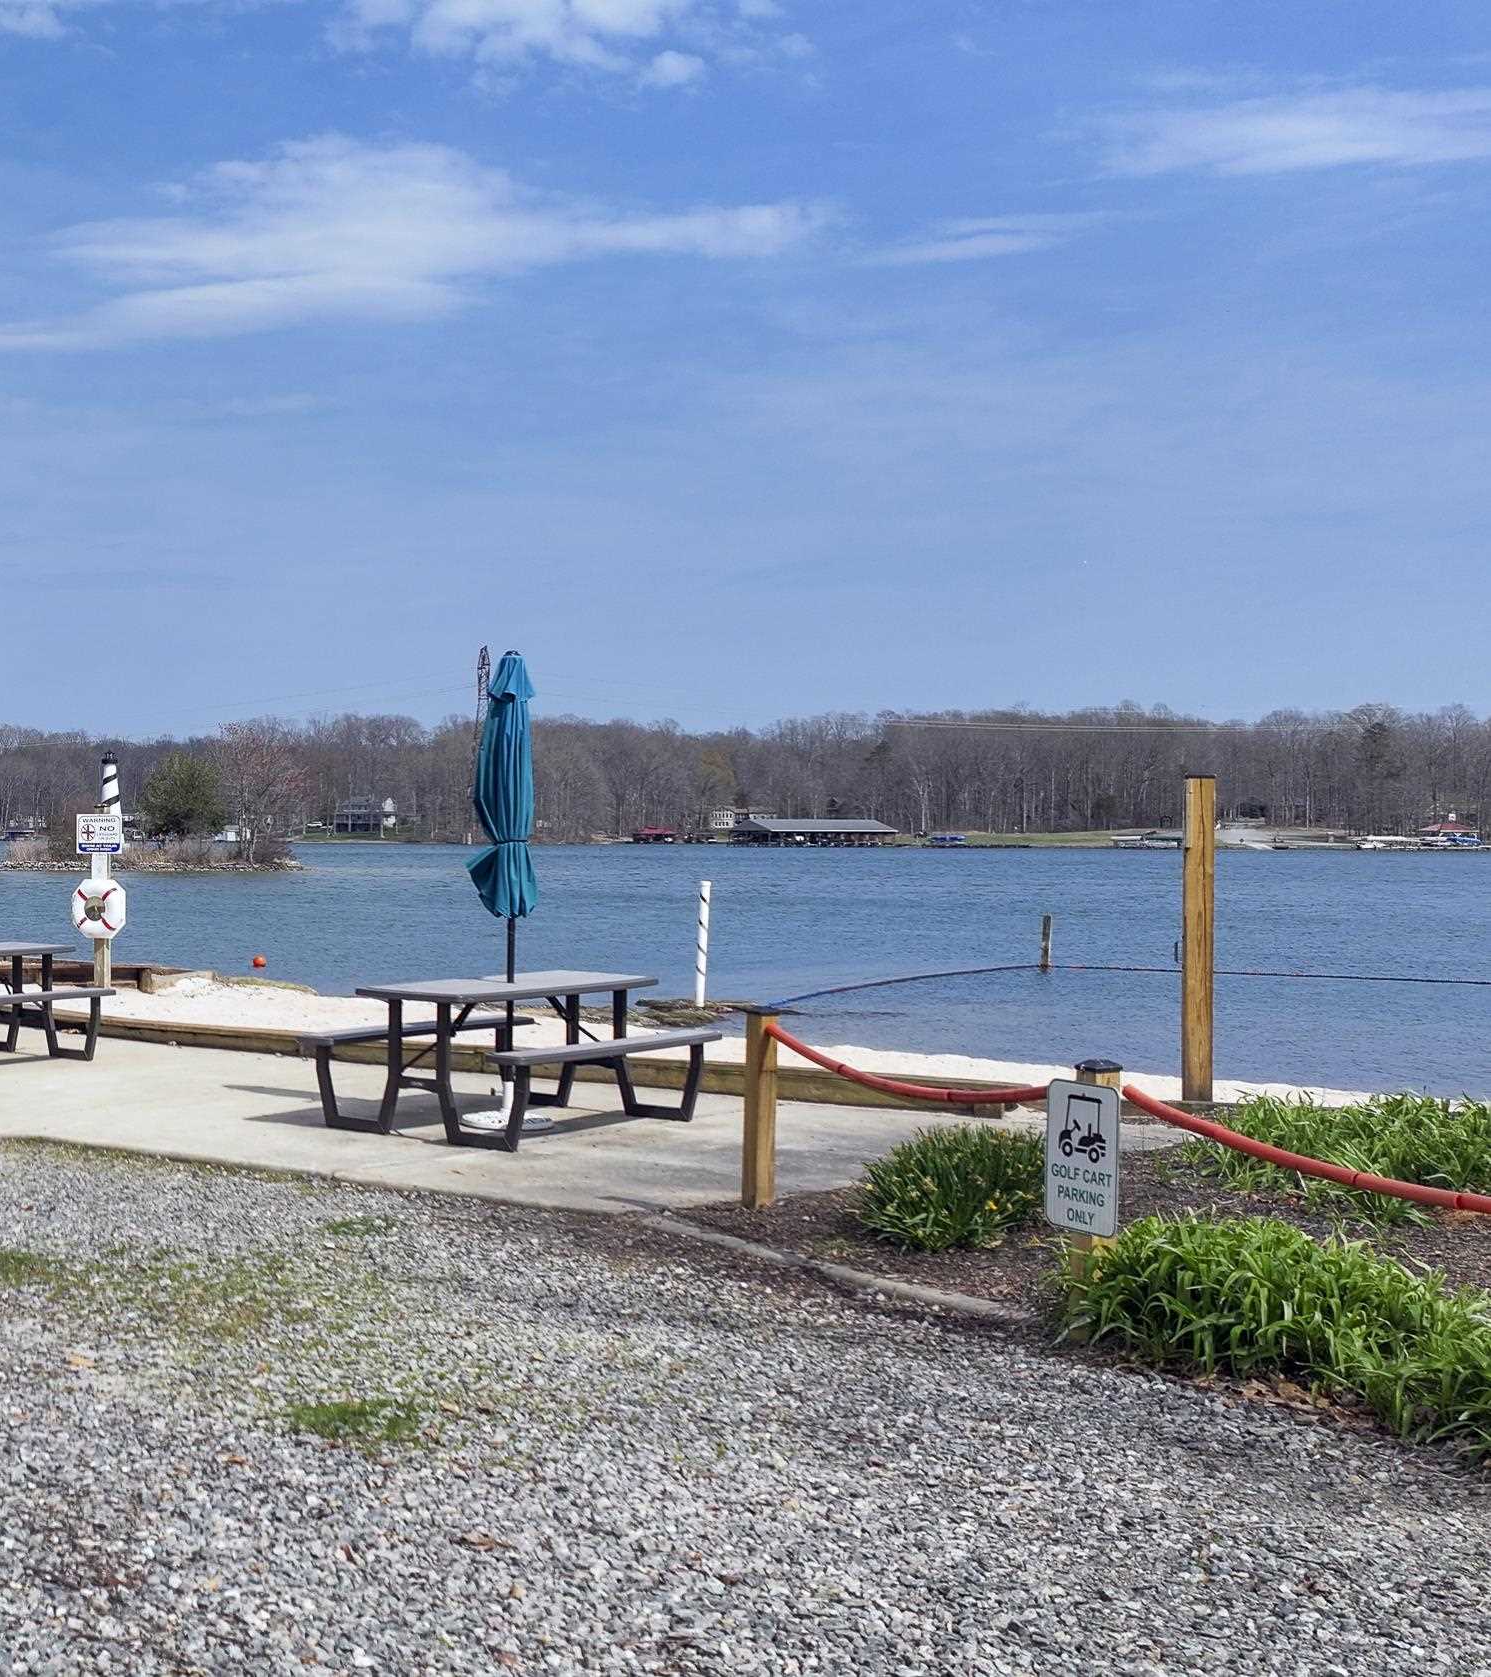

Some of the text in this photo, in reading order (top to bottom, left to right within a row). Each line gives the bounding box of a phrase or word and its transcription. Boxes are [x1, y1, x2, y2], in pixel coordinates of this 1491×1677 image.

[1051, 1163, 1112, 1187] GOLF CART
[1057, 1185, 1105, 1207] PARKING
[1066, 1208, 1094, 1226] ONLY
